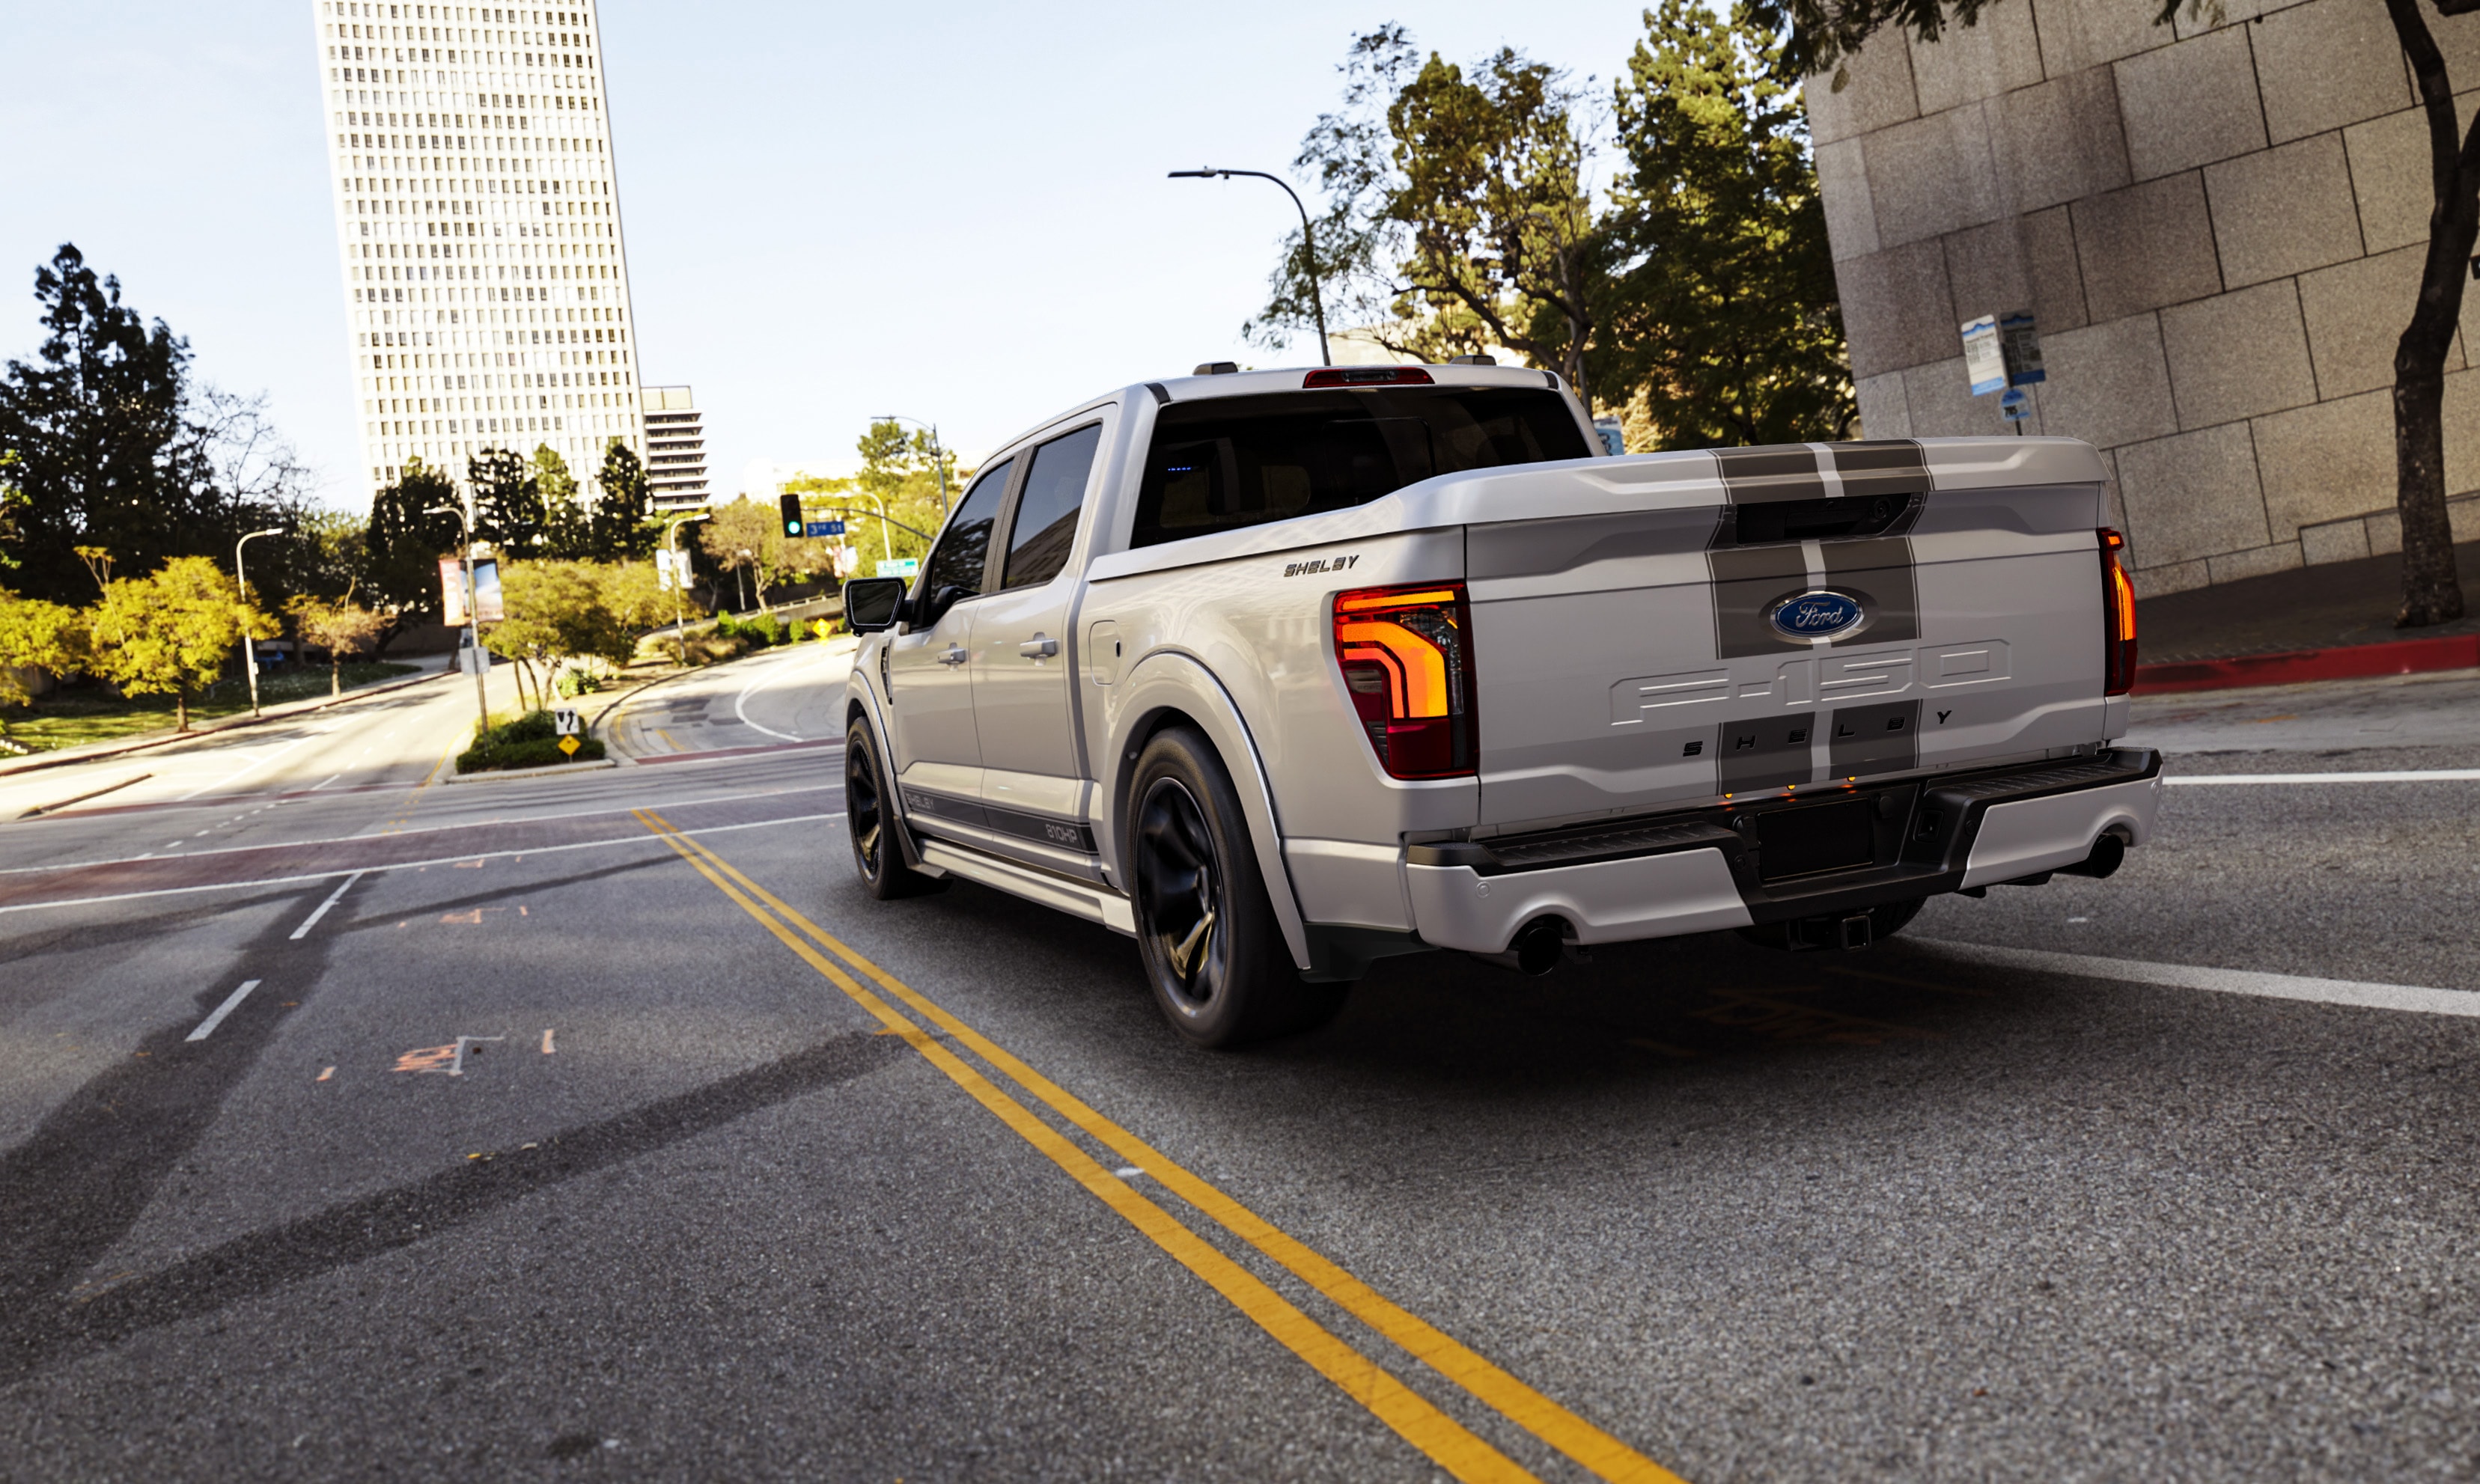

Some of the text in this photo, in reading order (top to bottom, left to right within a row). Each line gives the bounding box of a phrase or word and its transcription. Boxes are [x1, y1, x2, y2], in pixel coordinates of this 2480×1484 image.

[810, 524, 841, 534] 3rd St
[1284, 555, 1360, 577] SHELBY
[1795, 601, 1844, 628] Ford
[1609, 639, 2011, 725] F-150
[1683, 709, 1952, 757] SHELBY
[905, 793, 934, 810] SHELBY
[1045, 823, 1077, 843] 810HP
